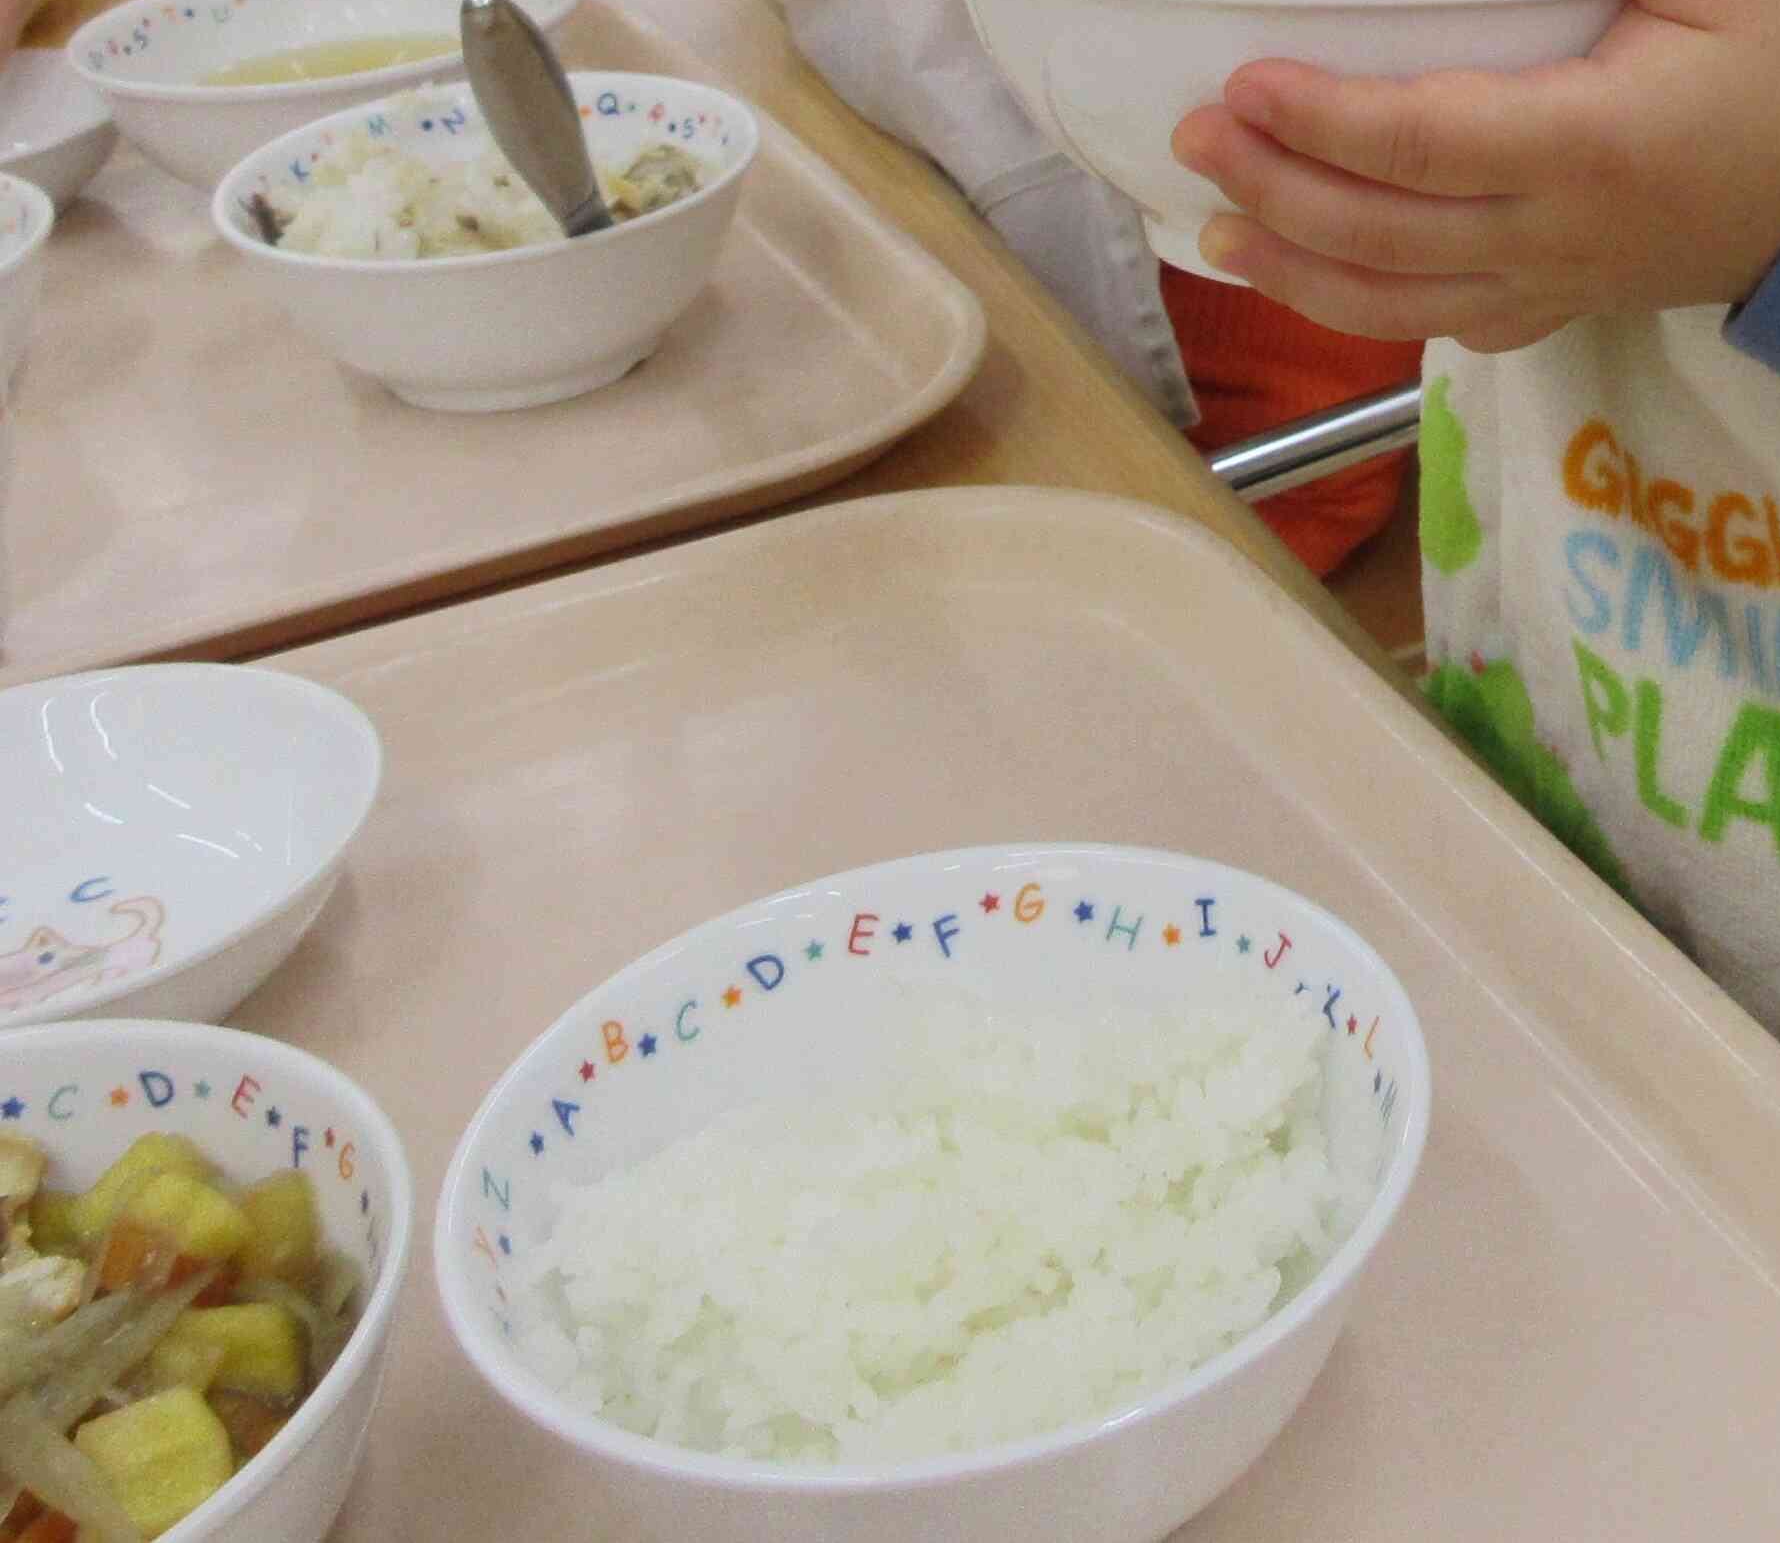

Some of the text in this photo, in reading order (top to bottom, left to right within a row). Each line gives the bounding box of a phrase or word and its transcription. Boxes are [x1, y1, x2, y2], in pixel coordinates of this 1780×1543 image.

[597, 92, 620, 116] Q
[552, 1098, 580, 1137] A
[602, 1020, 630, 1064] B
[676, 1000, 701, 1042] C
[747, 953, 786, 992] D
[847, 912, 880, 956] E
[932, 915, 962, 958] F
[1013, 882, 1045, 924] G
[1105, 905, 1144, 952] H
[1196, 898, 1217, 937] I
[1264, 929, 1293, 969] J
[48, 1086, 79, 1121] C
[138, 1070, 174, 1108] D
[231, 1074, 263, 1119] E
[292, 1126, 309, 1169] F
